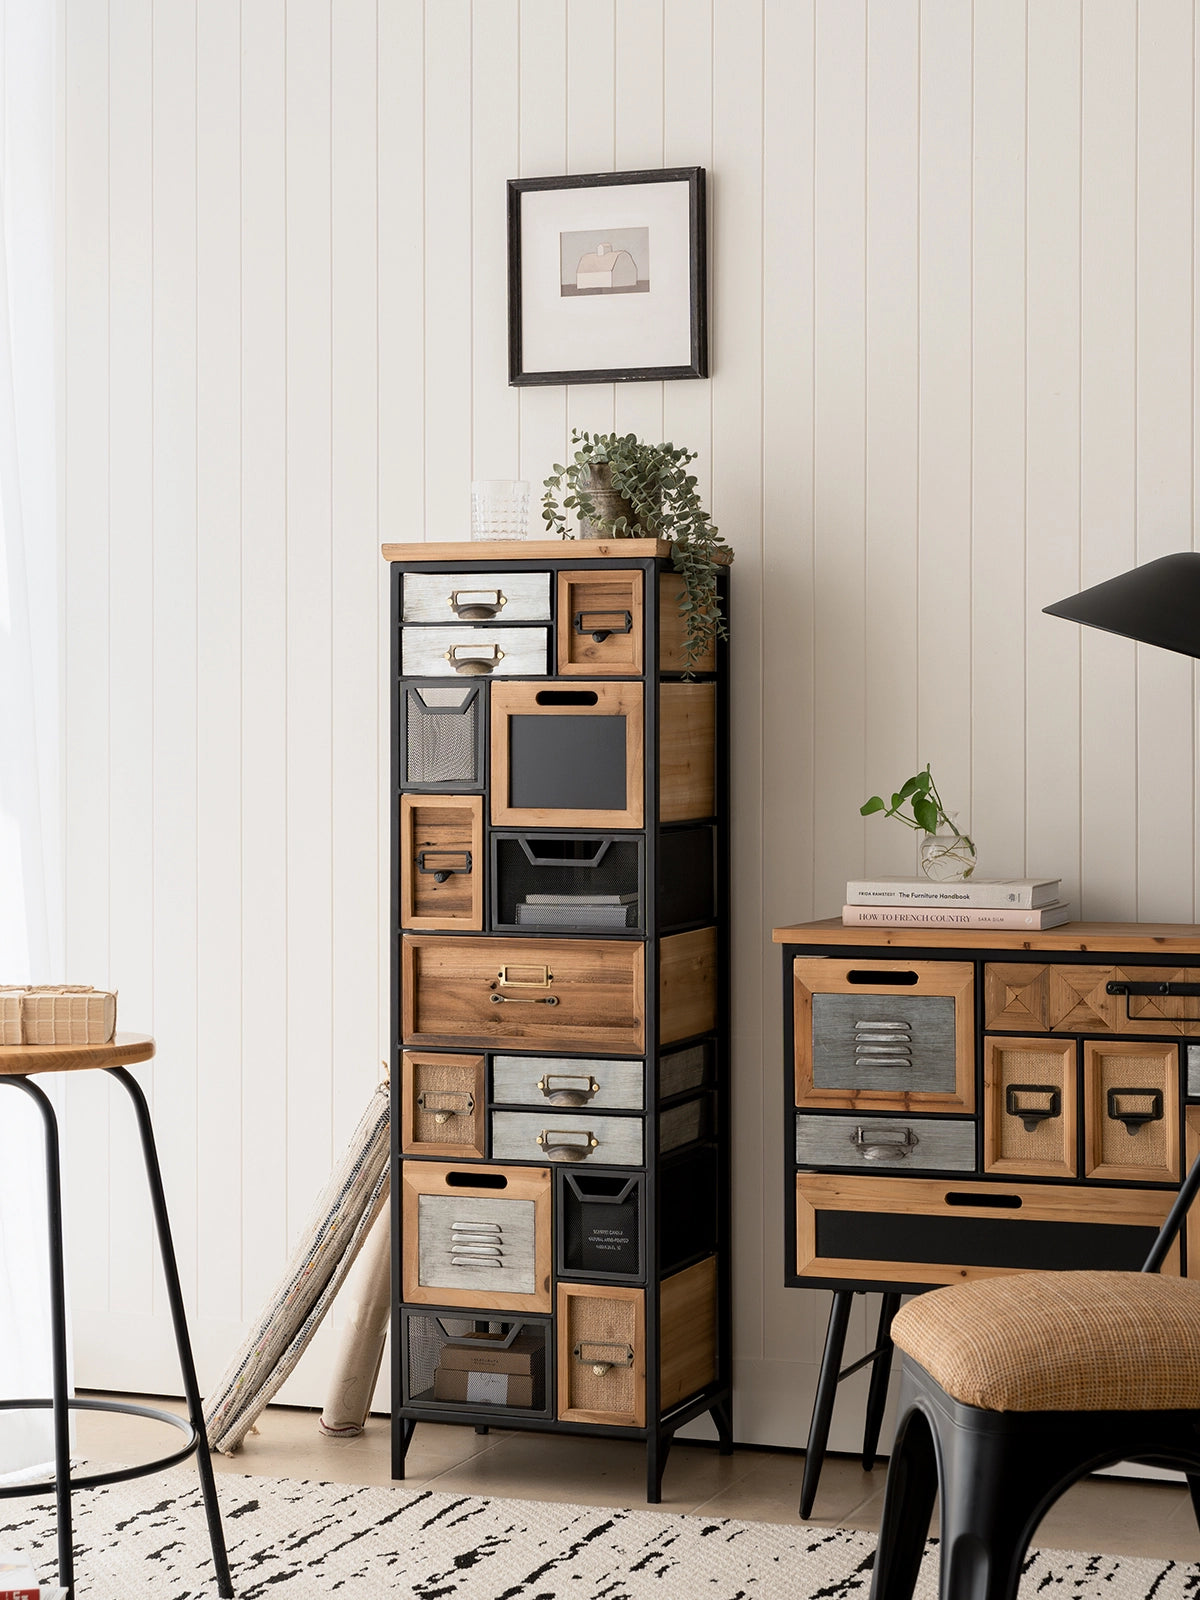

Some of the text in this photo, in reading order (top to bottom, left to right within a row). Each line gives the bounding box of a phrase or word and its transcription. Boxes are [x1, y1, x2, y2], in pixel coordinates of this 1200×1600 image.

[858, 913, 971, 923] HOW TO FRENCH COUNTRY
